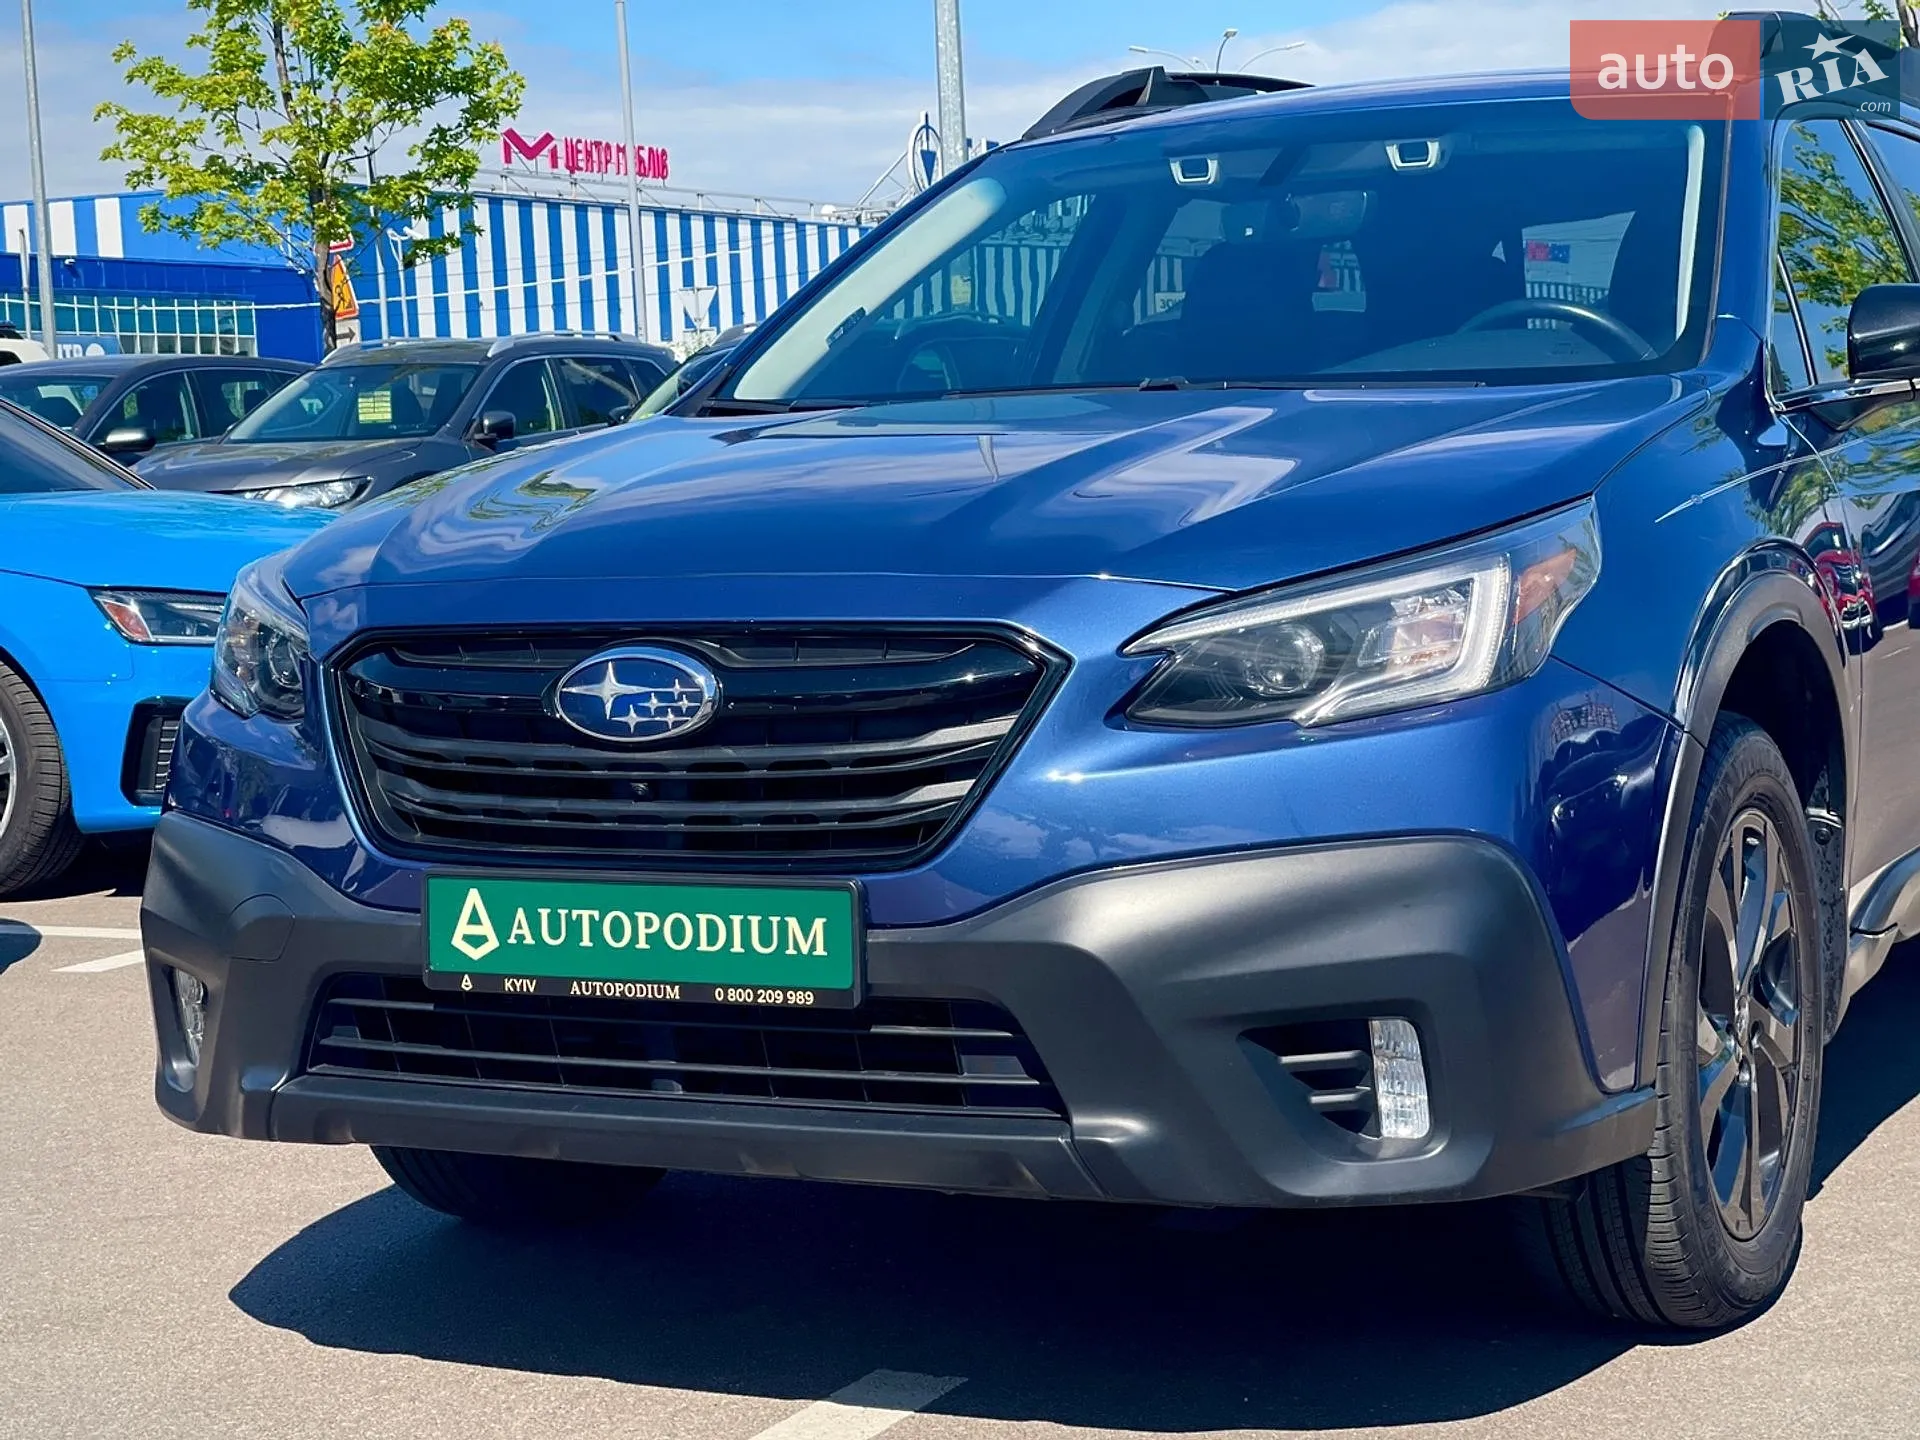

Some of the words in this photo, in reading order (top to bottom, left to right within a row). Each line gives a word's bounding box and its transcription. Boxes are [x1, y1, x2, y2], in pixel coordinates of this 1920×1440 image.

[564, 138, 612, 174] ЦЕНТР
[616, 143, 669, 180] МБЛІВ
[507, 907, 829, 956] AUTOPODIUM
[504, 978, 537, 993] KYIV
[570, 981, 681, 1000] AUTOPODIUM
[714, 987, 724, 1002] 0
[727, 988, 753, 1003] 800
[757, 989, 784, 1004] 209
[787, 990, 814, 1005] 989
